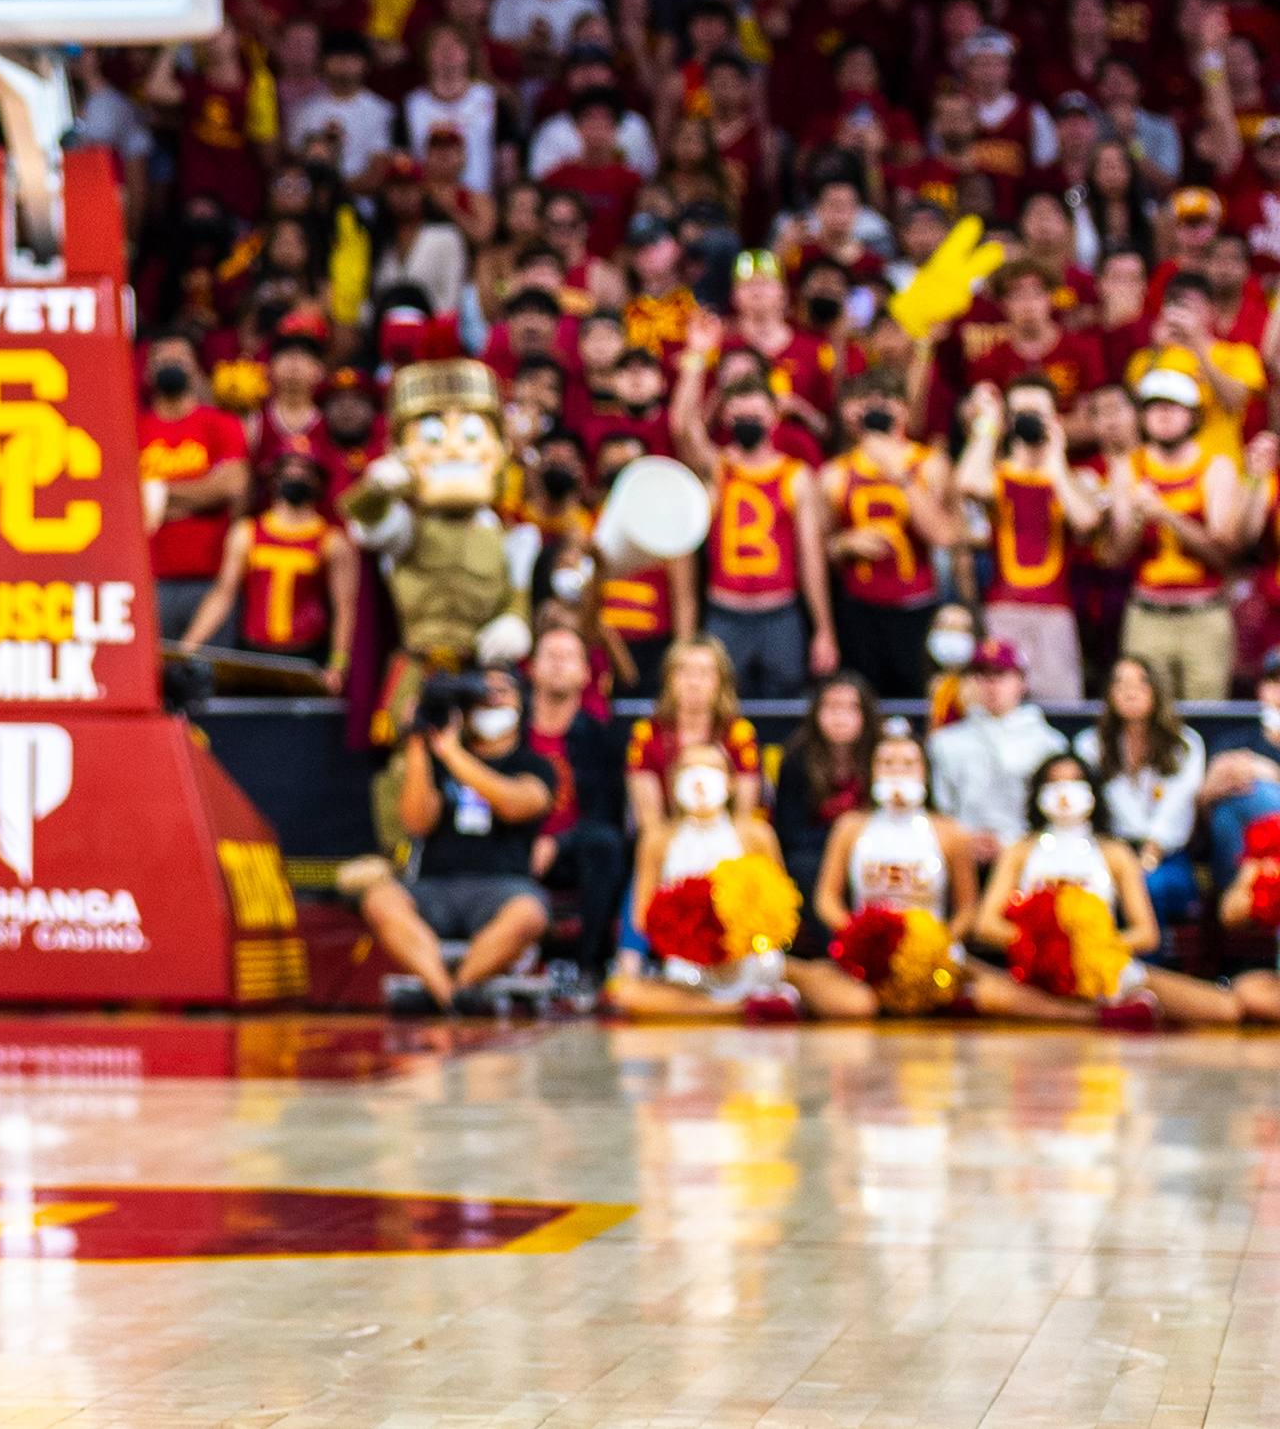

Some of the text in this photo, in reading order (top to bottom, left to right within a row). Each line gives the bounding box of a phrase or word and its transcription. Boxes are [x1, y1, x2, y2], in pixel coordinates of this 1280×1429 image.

[721, 481, 782, 577] B
[996, 494, 1065, 588] U
[248, 546, 318, 643] T
[32, 923, 143, 953] CASINO
